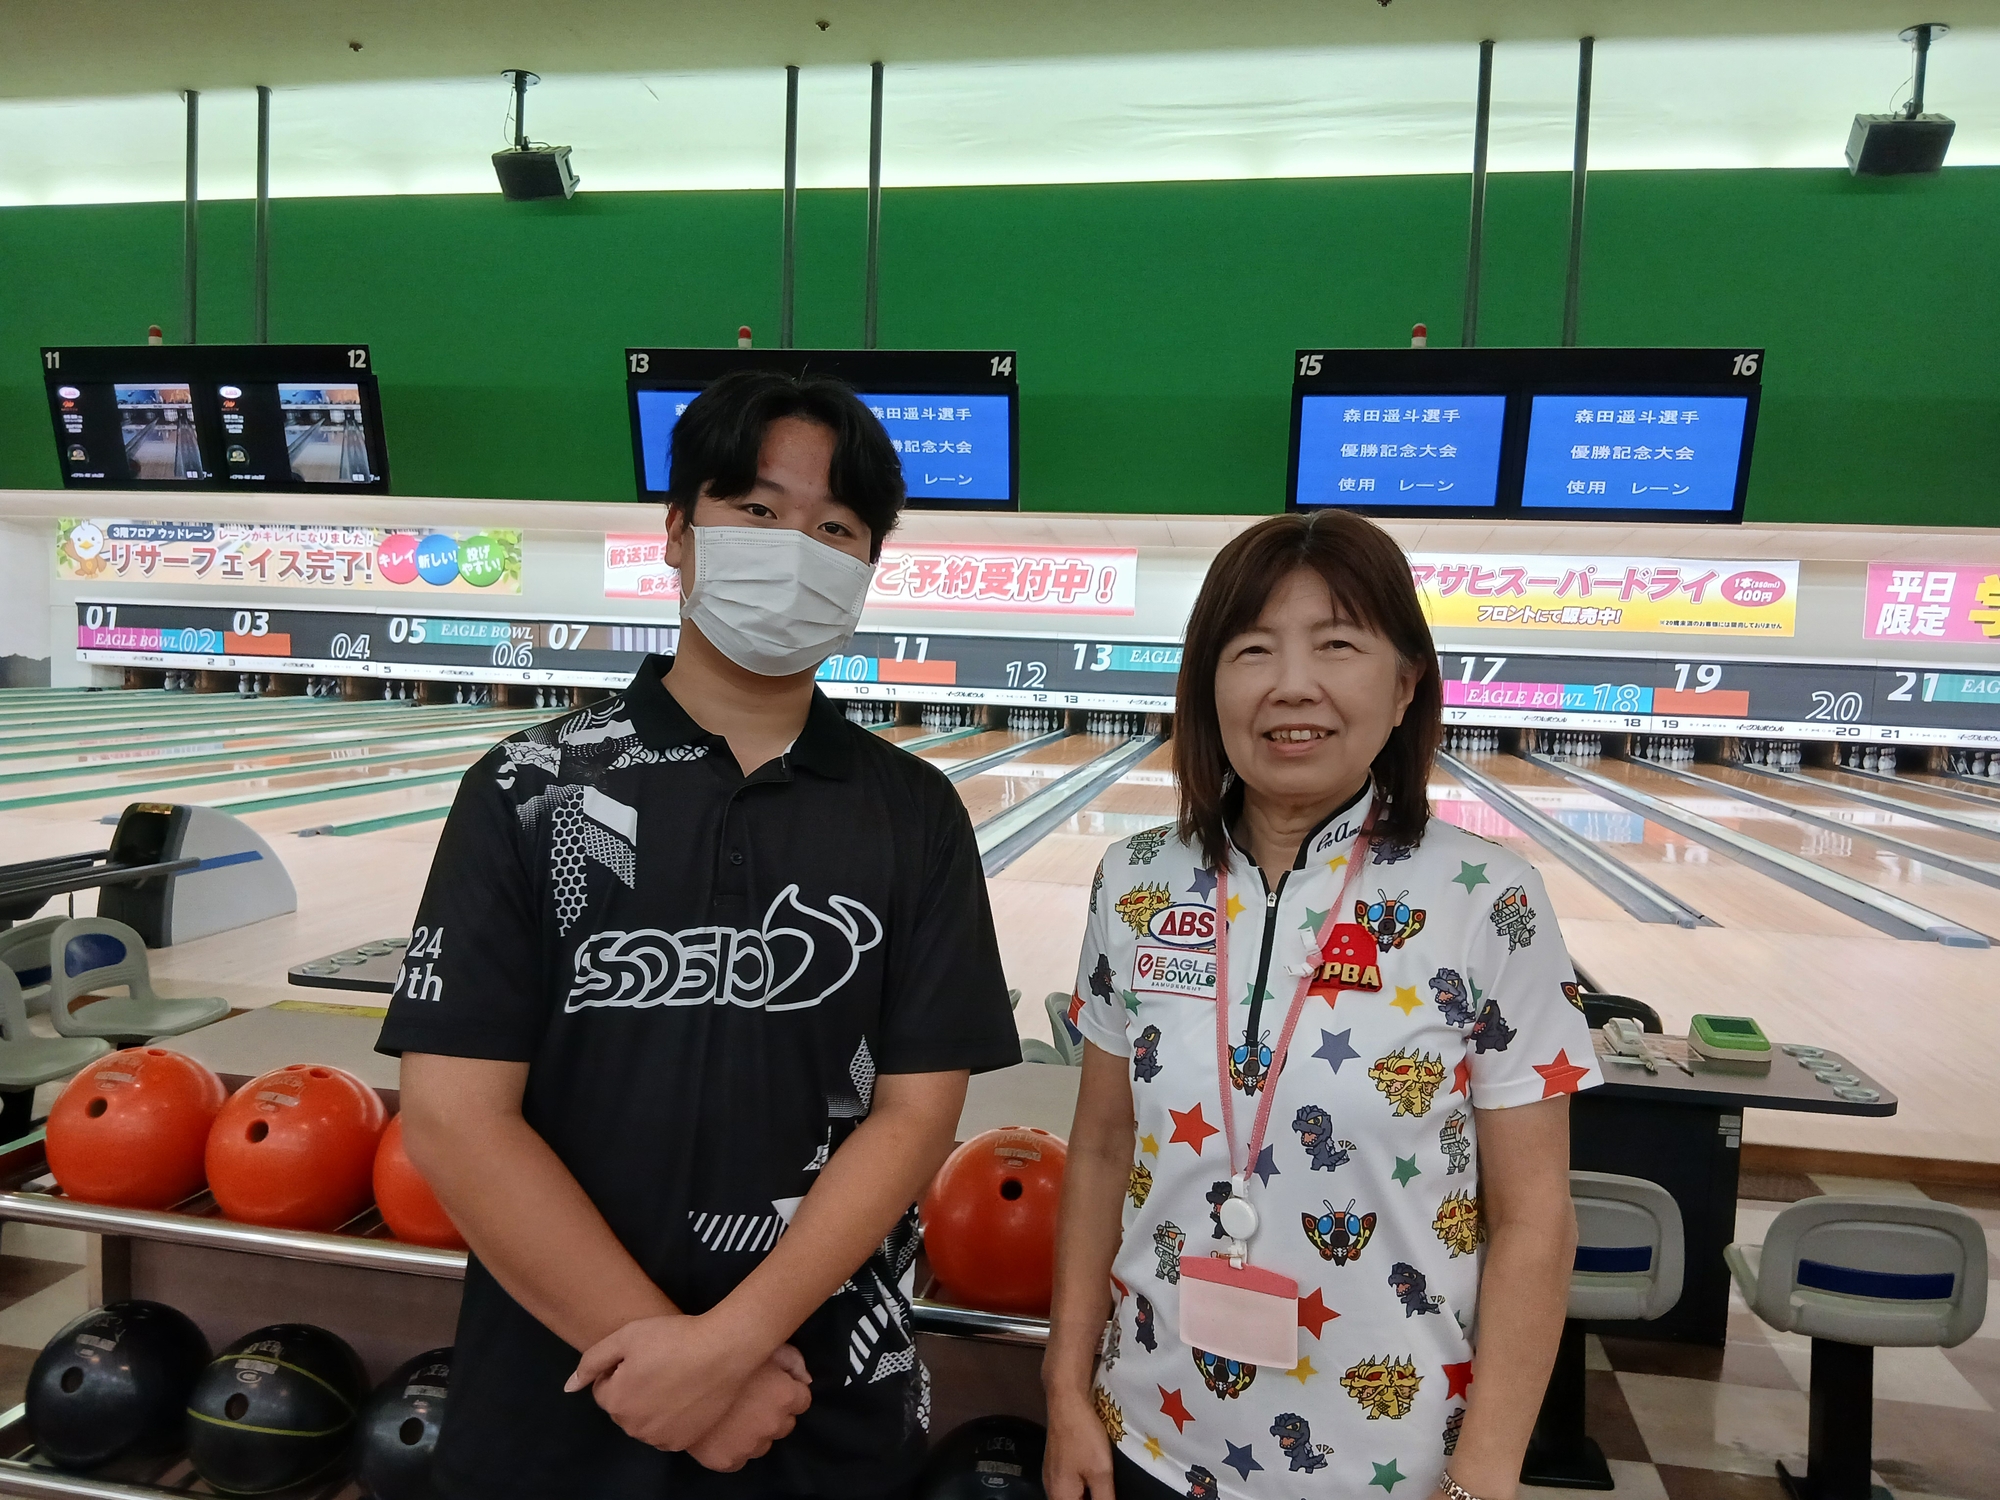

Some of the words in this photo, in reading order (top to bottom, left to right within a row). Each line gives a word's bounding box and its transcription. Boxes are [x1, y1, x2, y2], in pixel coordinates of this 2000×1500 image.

[45, 351, 60, 369] 11
[347, 350, 366, 368] 12
[629, 353, 649, 373] 13
[990, 356, 1012, 376] 14
[1299, 354, 1324, 376] 15
[1732, 353, 1759, 376] 16
[1340, 443, 1458, 458] 優勝記念大会
[1571, 445, 1695, 460] 優勝記念大会
[924, 473, 973, 485] レーン
[1338, 478, 1375, 492] 使用
[1399, 479, 1454, 492] レーン
[1567, 480, 1606, 495] 使用
[1631, 482, 1690, 495] レーン
[111, 544, 372, 582] リサーフェイス完了!
[379, 549, 415, 568] キレイ
[875, 557, 1114, 600] ご予約受付中！
[1409, 565, 1719, 603] アサヒスーパードライ
[1886, 570, 1957, 603] 平日
[1733, 589, 1773, 602] 400円
[86, 606, 118, 631] 01
[233, 611, 270, 637] 03
[1478, 605, 1623, 626] フロントにて販売中!
[1875, 603, 1951, 636] 限定
[389, 617, 427, 644] 05
[441, 623, 488, 638] EAGLE
[490, 625, 534, 640] BOWL
[548, 623, 590, 650] 07
[95, 633, 137, 648] EAGLE
[140, 634, 179, 650] BOWL
[179, 627, 216, 654] 02
[331, 633, 370, 659] 04
[894, 636, 929, 663] 11
[83, 652, 88, 660] 1
[207, 658, 215, 666] 2
[493, 641, 533, 667] 06
[1073, 643, 1113, 671] 13
[362, 664, 370, 672] 4
[383, 666, 391, 674] 5
[522, 672, 531, 680] 6
[545, 672, 554, 680] 7
[828, 654, 868, 681] 10
[1006, 661, 1048, 688] 12
[1459, 656, 1507, 685] 17
[1674, 663, 1722, 694] 19
[1887, 671, 1940, 702] 21
[854, 686, 869, 694] 10
[1033, 694, 1048, 702] 12
[1064, 695, 1078, 703] 13
[1467, 688, 1528, 705] EAGLE
[1531, 691, 1587, 707] BOWL
[1593, 683, 1641, 712] 18
[1450, 711, 1467, 719] 17
[1805, 690, 1863, 722] 20
[1624, 718, 1641, 727] 18
[1661, 720, 1679, 728] 19
[1835, 727, 1861, 736] 20
[1881, 729, 1900, 738] 21
[1158, 910, 1215, 938] ABS
[1155, 956, 1217, 974] EAGLE
[1313, 962, 1380, 987] PBA
[1152, 969, 1215, 987] BOWL
